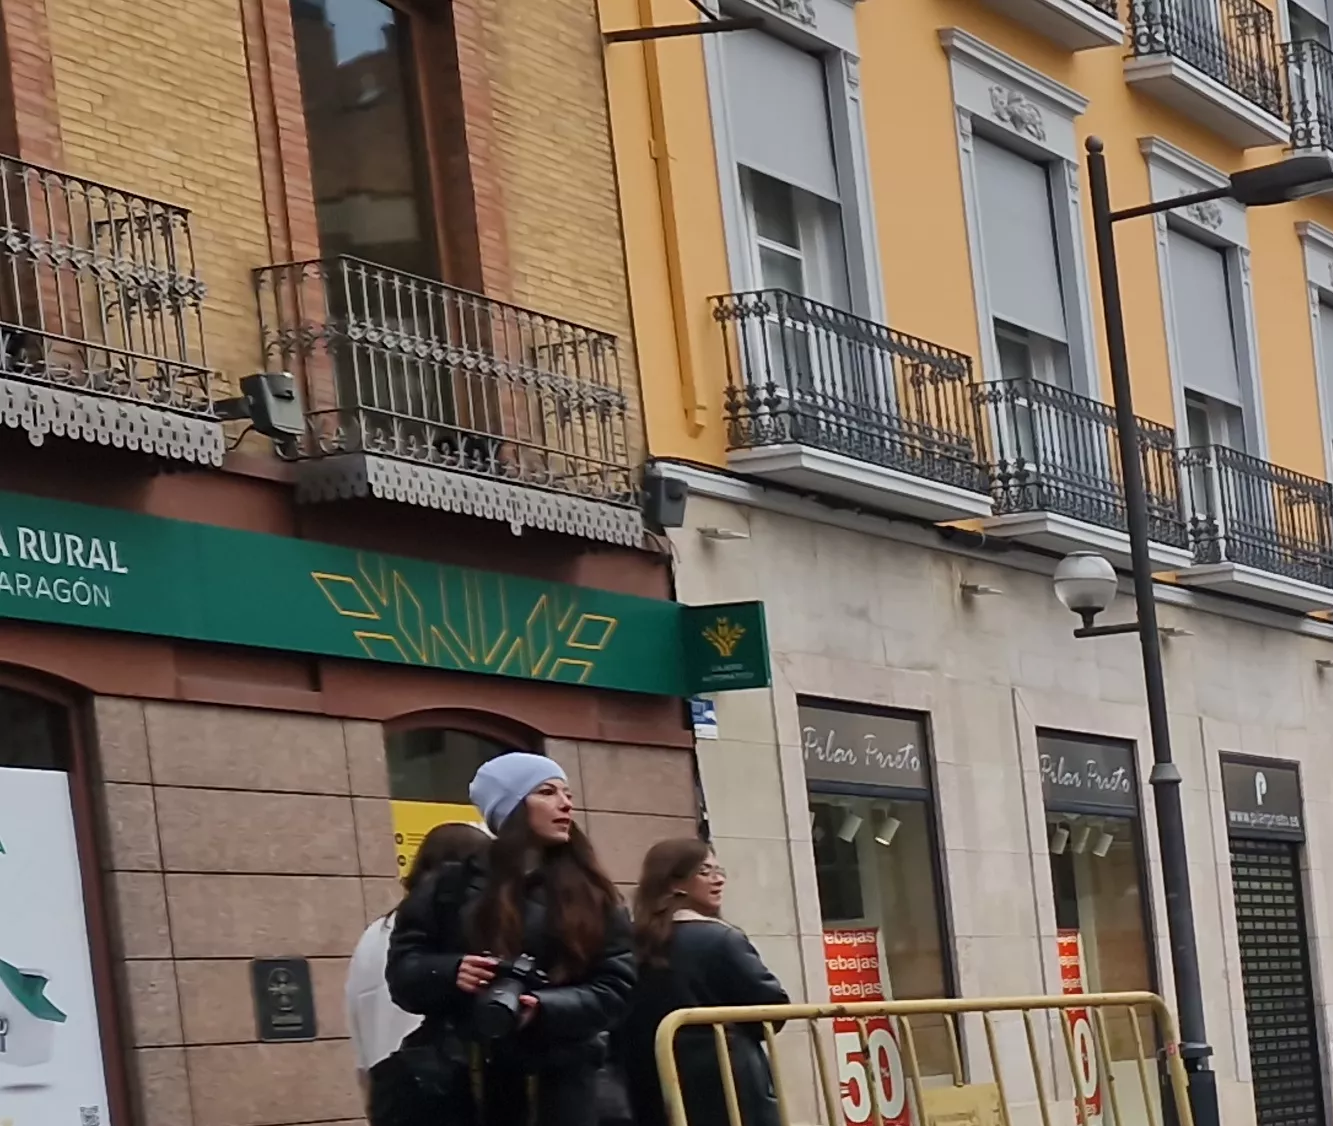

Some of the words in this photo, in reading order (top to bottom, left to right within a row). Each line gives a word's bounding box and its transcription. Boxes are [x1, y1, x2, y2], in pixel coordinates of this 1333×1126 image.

[17, 526, 129, 574] RURAL
[0, 571, 111, 608] ARAGÓN
[803, 726, 858, 766] Pilar
[864, 734, 920, 772] Prieto
[1040, 754, 1081, 788] Pilar
[824, 931, 876, 947] ebajas
[835, 1028, 905, 1123] 50
